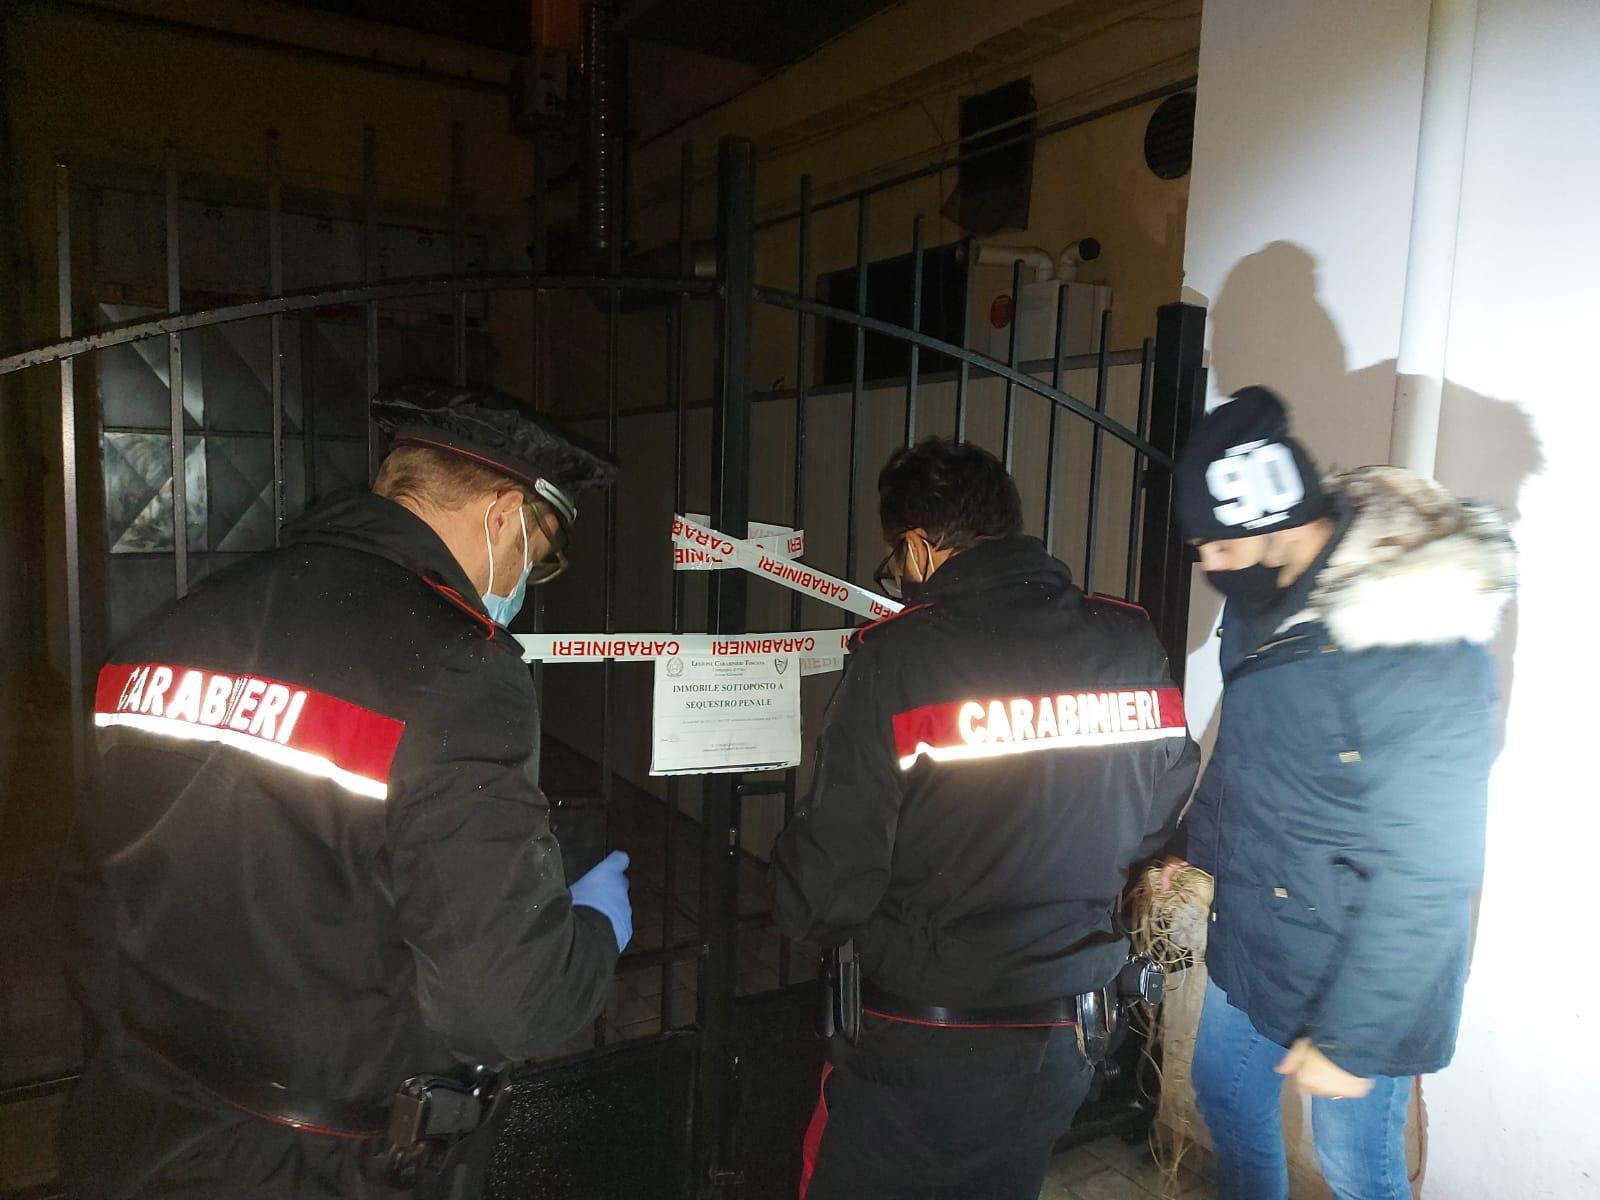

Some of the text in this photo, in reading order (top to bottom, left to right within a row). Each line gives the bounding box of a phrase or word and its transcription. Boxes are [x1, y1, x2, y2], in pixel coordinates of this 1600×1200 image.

[1205, 441, 1305, 526] 90
[758, 555, 849, 602] CARABINIERI
[552, 640, 680, 657] CARABINIERI
[712, 636, 816, 656] CARABINIERI
[672, 682, 784, 693] IMMOBILE SOTTOPOSTO A
[685, 698, 773, 709] SEQUESTRO PENALE
[958, 690, 1161, 745] CARABINIERI
